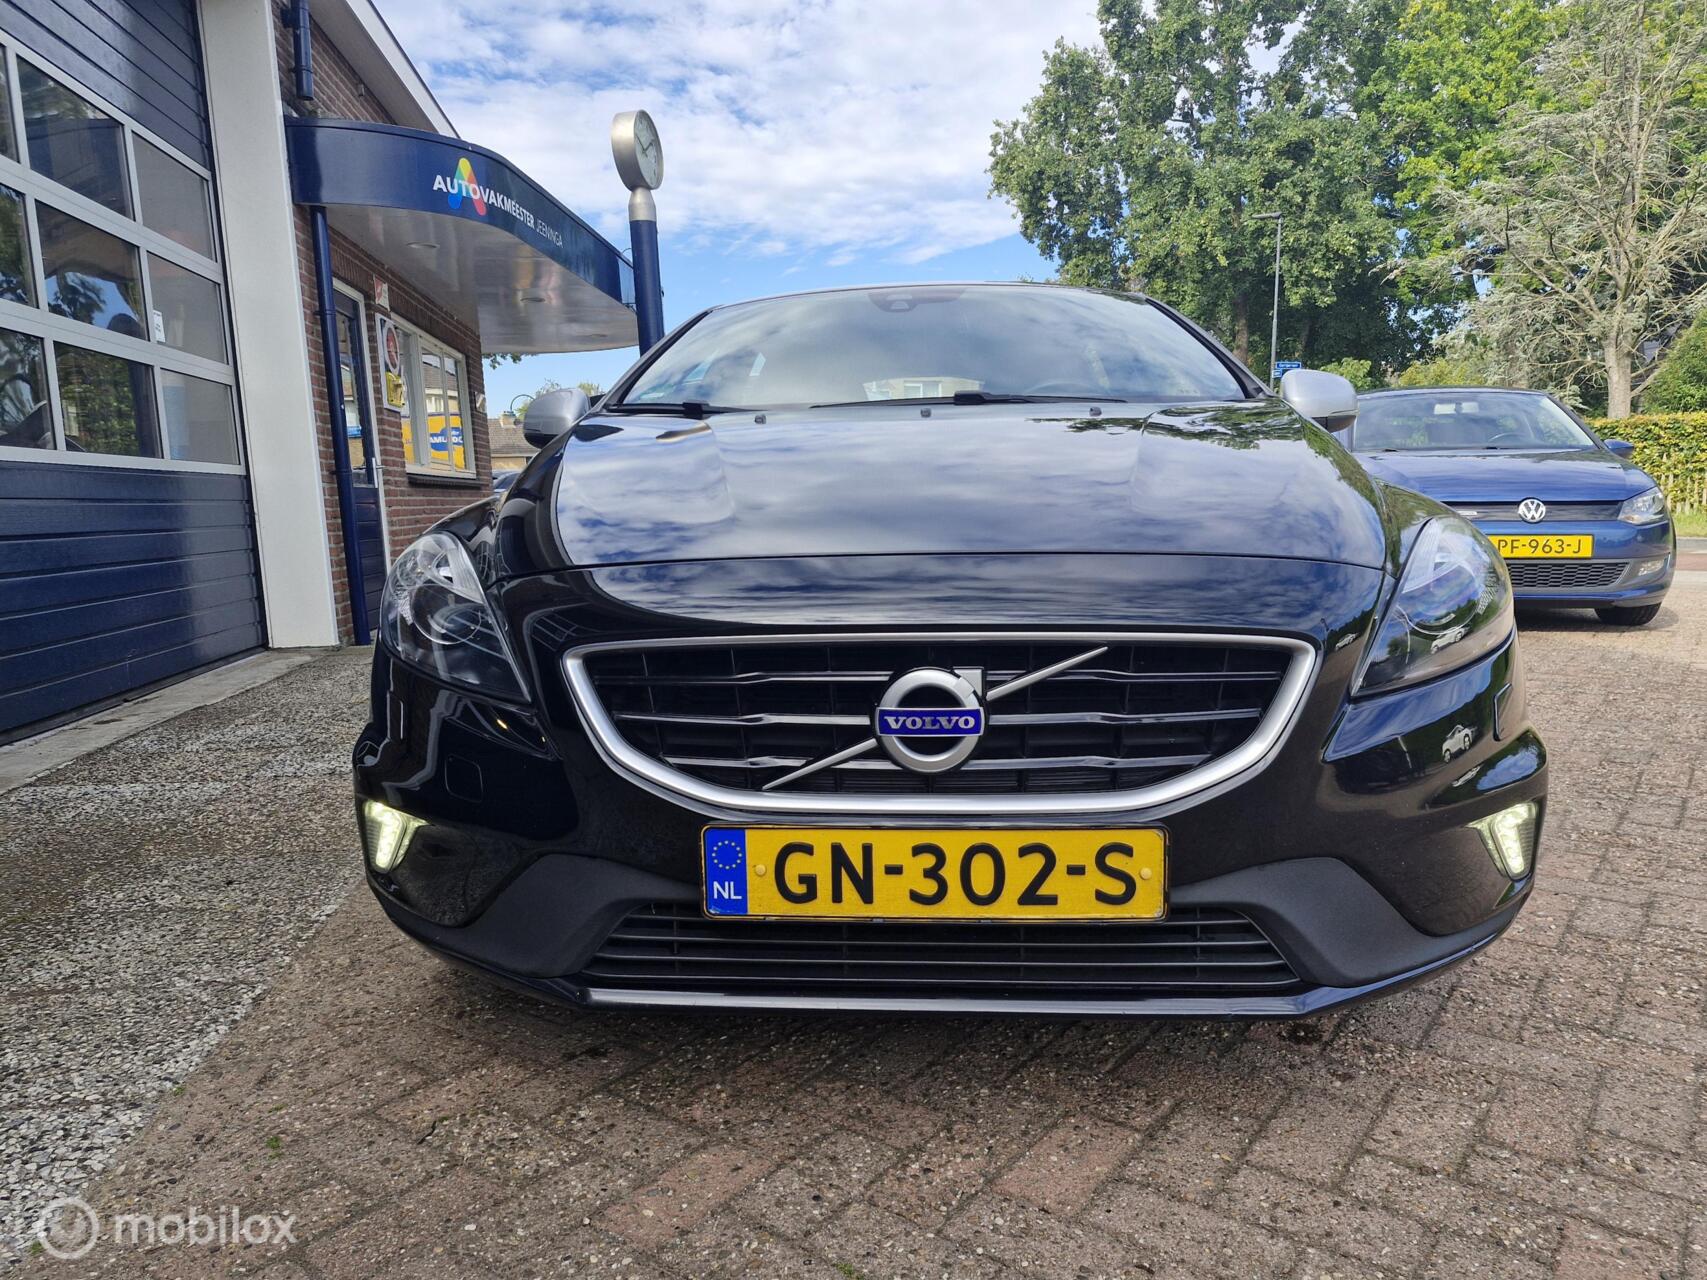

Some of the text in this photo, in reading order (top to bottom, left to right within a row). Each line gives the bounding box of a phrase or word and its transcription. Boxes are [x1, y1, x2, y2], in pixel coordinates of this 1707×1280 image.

[433, 174, 535, 230] AUTOVAKMEESTER
[1497, 538, 1582, 554] PF-963-J
[883, 715, 976, 730] VOLVO
[773, 841, 1138, 906] GN-302-S
[712, 880, 743, 901] NL
